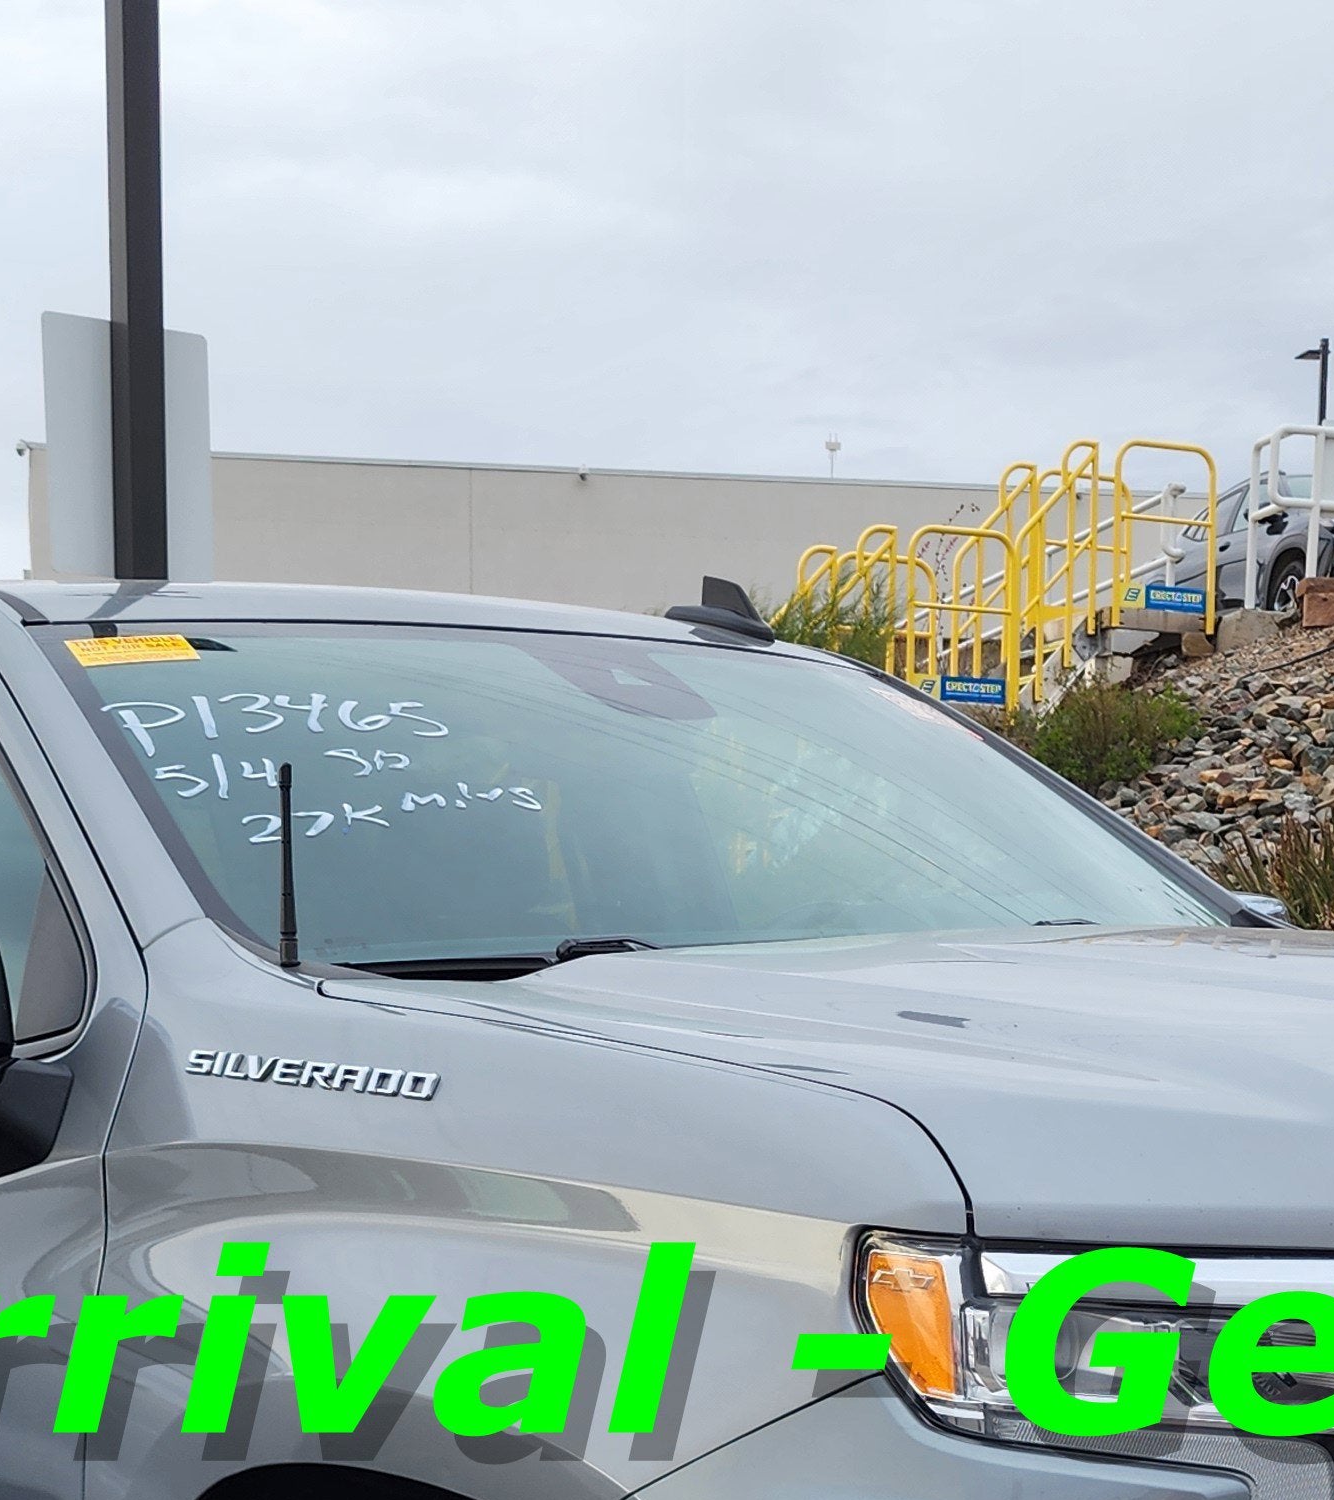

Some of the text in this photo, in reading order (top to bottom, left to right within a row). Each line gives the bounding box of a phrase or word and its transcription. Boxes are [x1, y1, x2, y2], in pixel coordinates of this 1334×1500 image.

[73, 635, 179, 647] THIS VEHICLE
[81, 643, 106, 652] NOT
[113, 642, 142, 650] FOR
[100, 693, 449, 758] P13465
[185, 1050, 441, 1101] SILVERADO
